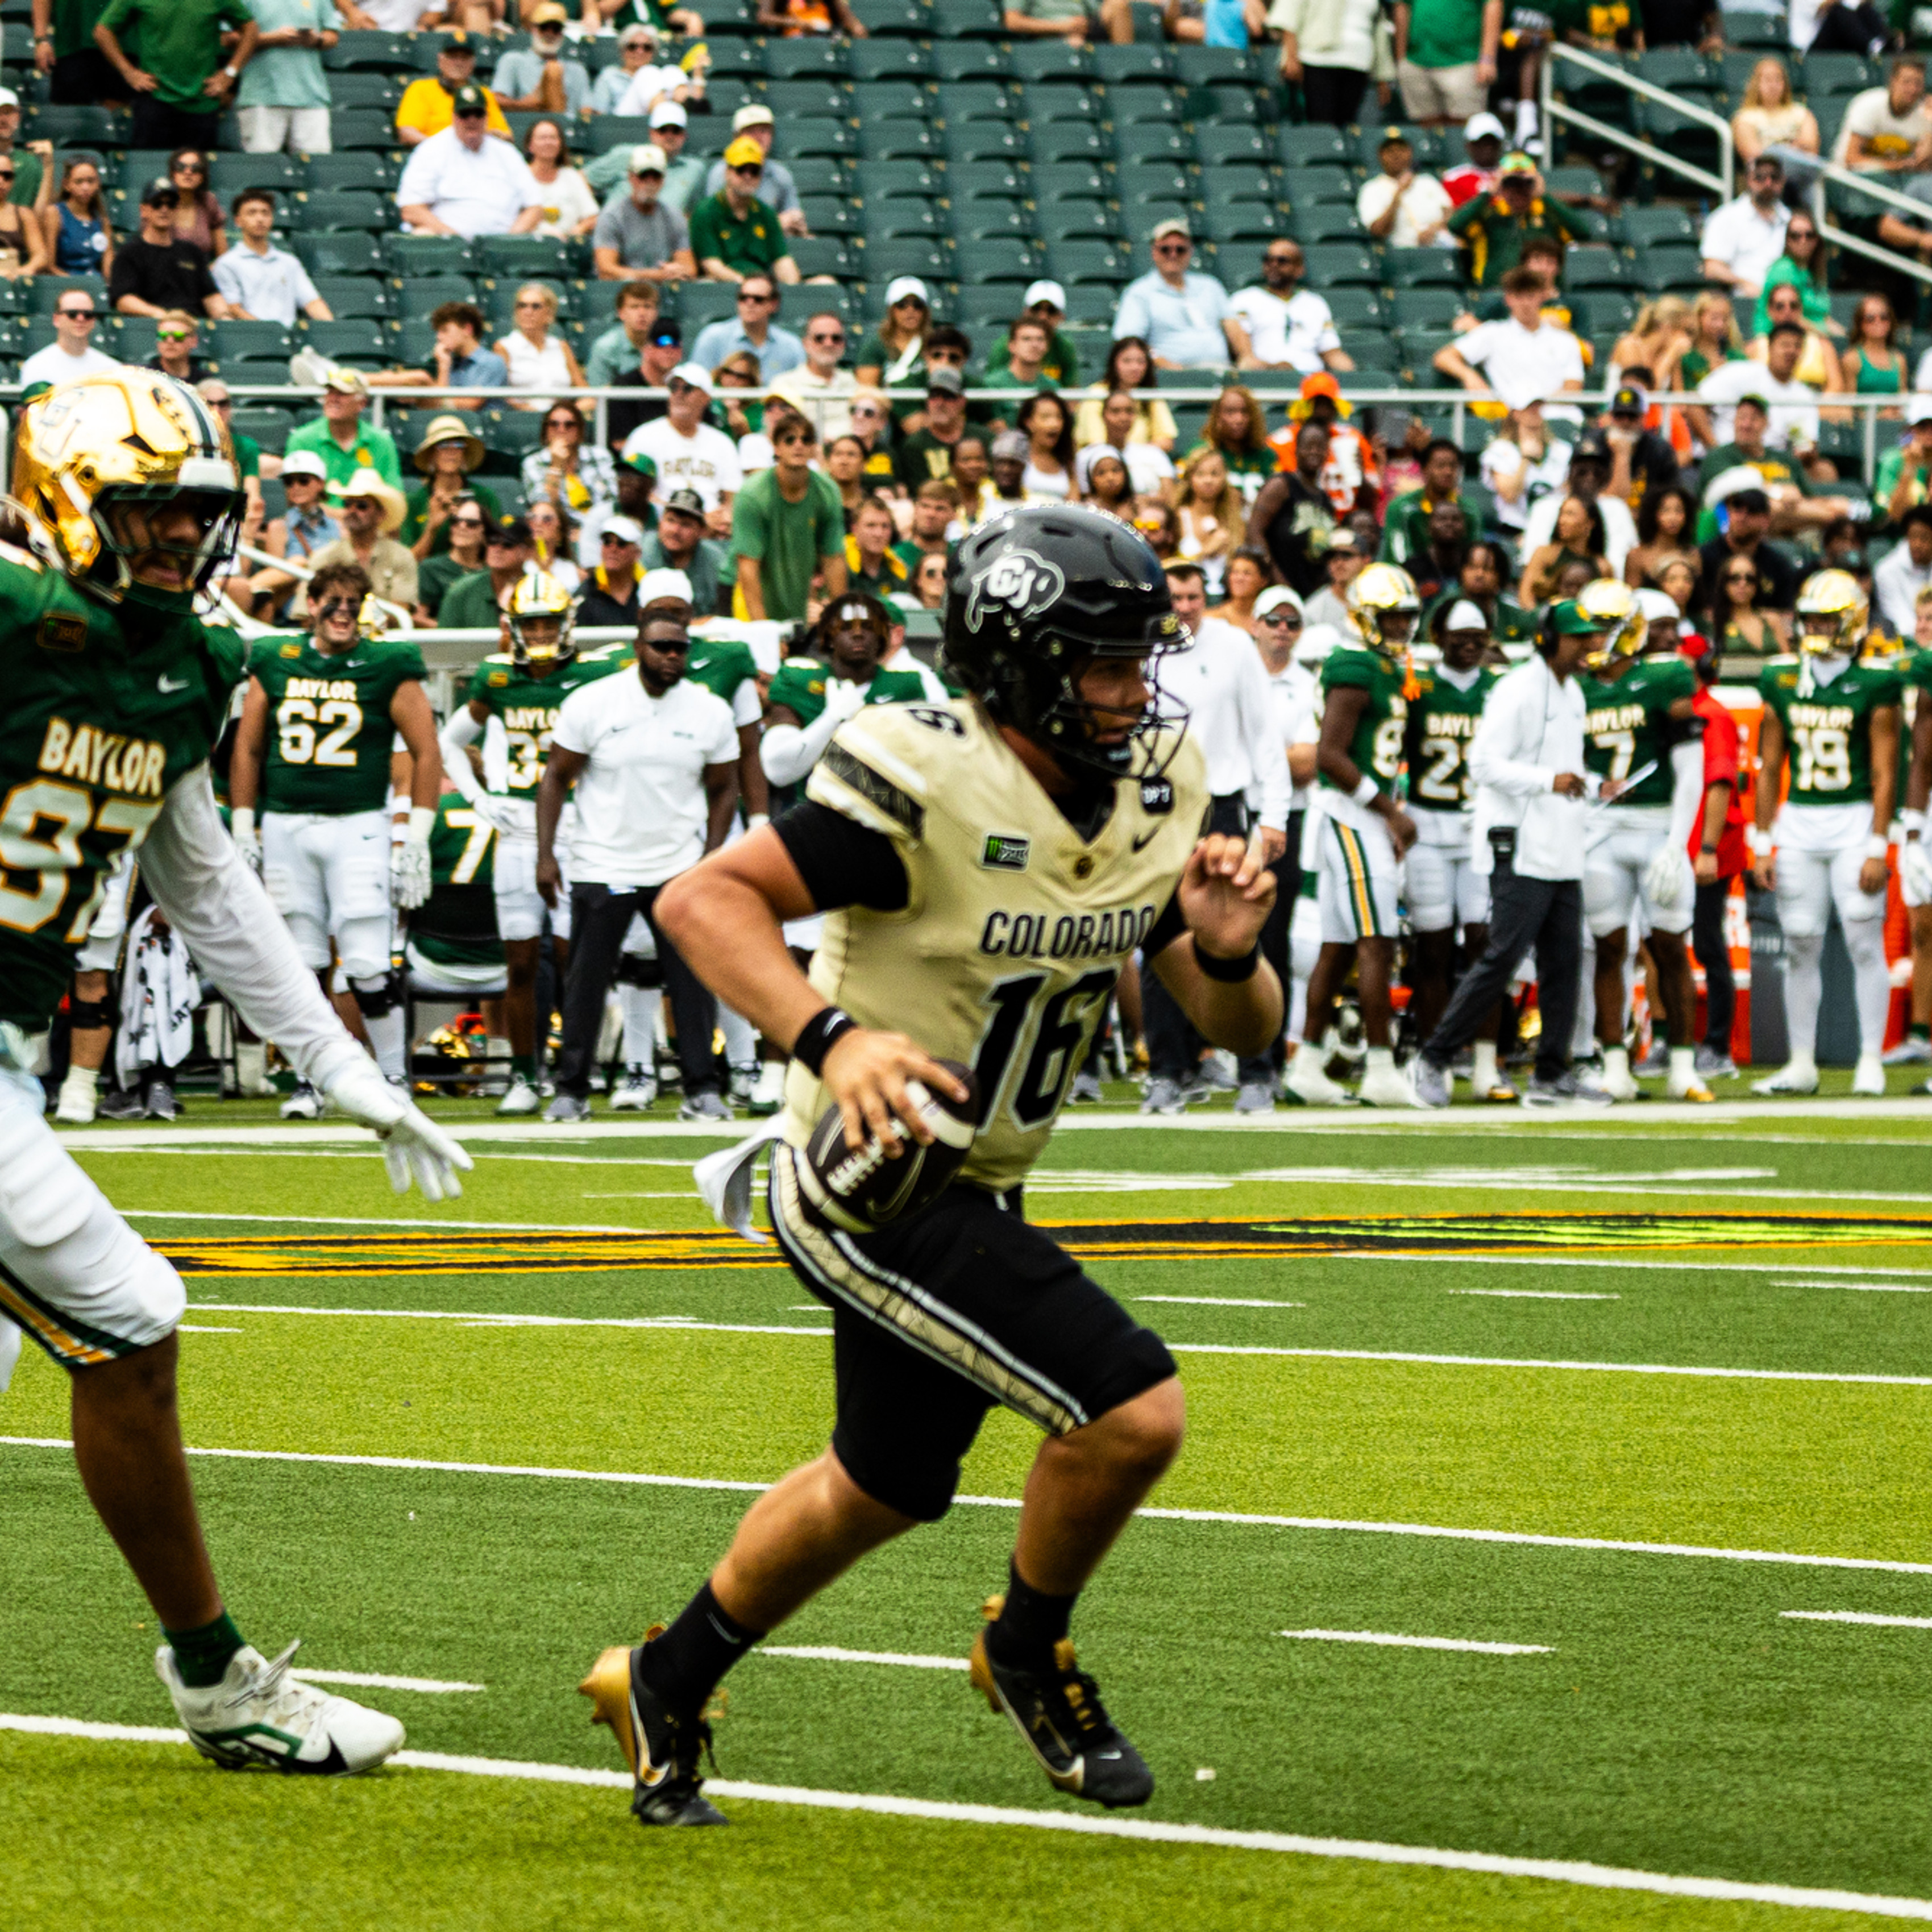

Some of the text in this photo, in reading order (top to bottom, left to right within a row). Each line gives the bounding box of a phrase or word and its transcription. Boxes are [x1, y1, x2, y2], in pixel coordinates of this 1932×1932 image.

[285, 677, 358, 701] BAYLOR
[38, 716, 167, 797] BAYLOR
[276, 699, 363, 766] 62
[1594, 729, 1635, 782] 7
[1793, 726, 1852, 791] 19
[979, 906, 1157, 959] COLORADO
[973, 966, 1121, 1132] 16
